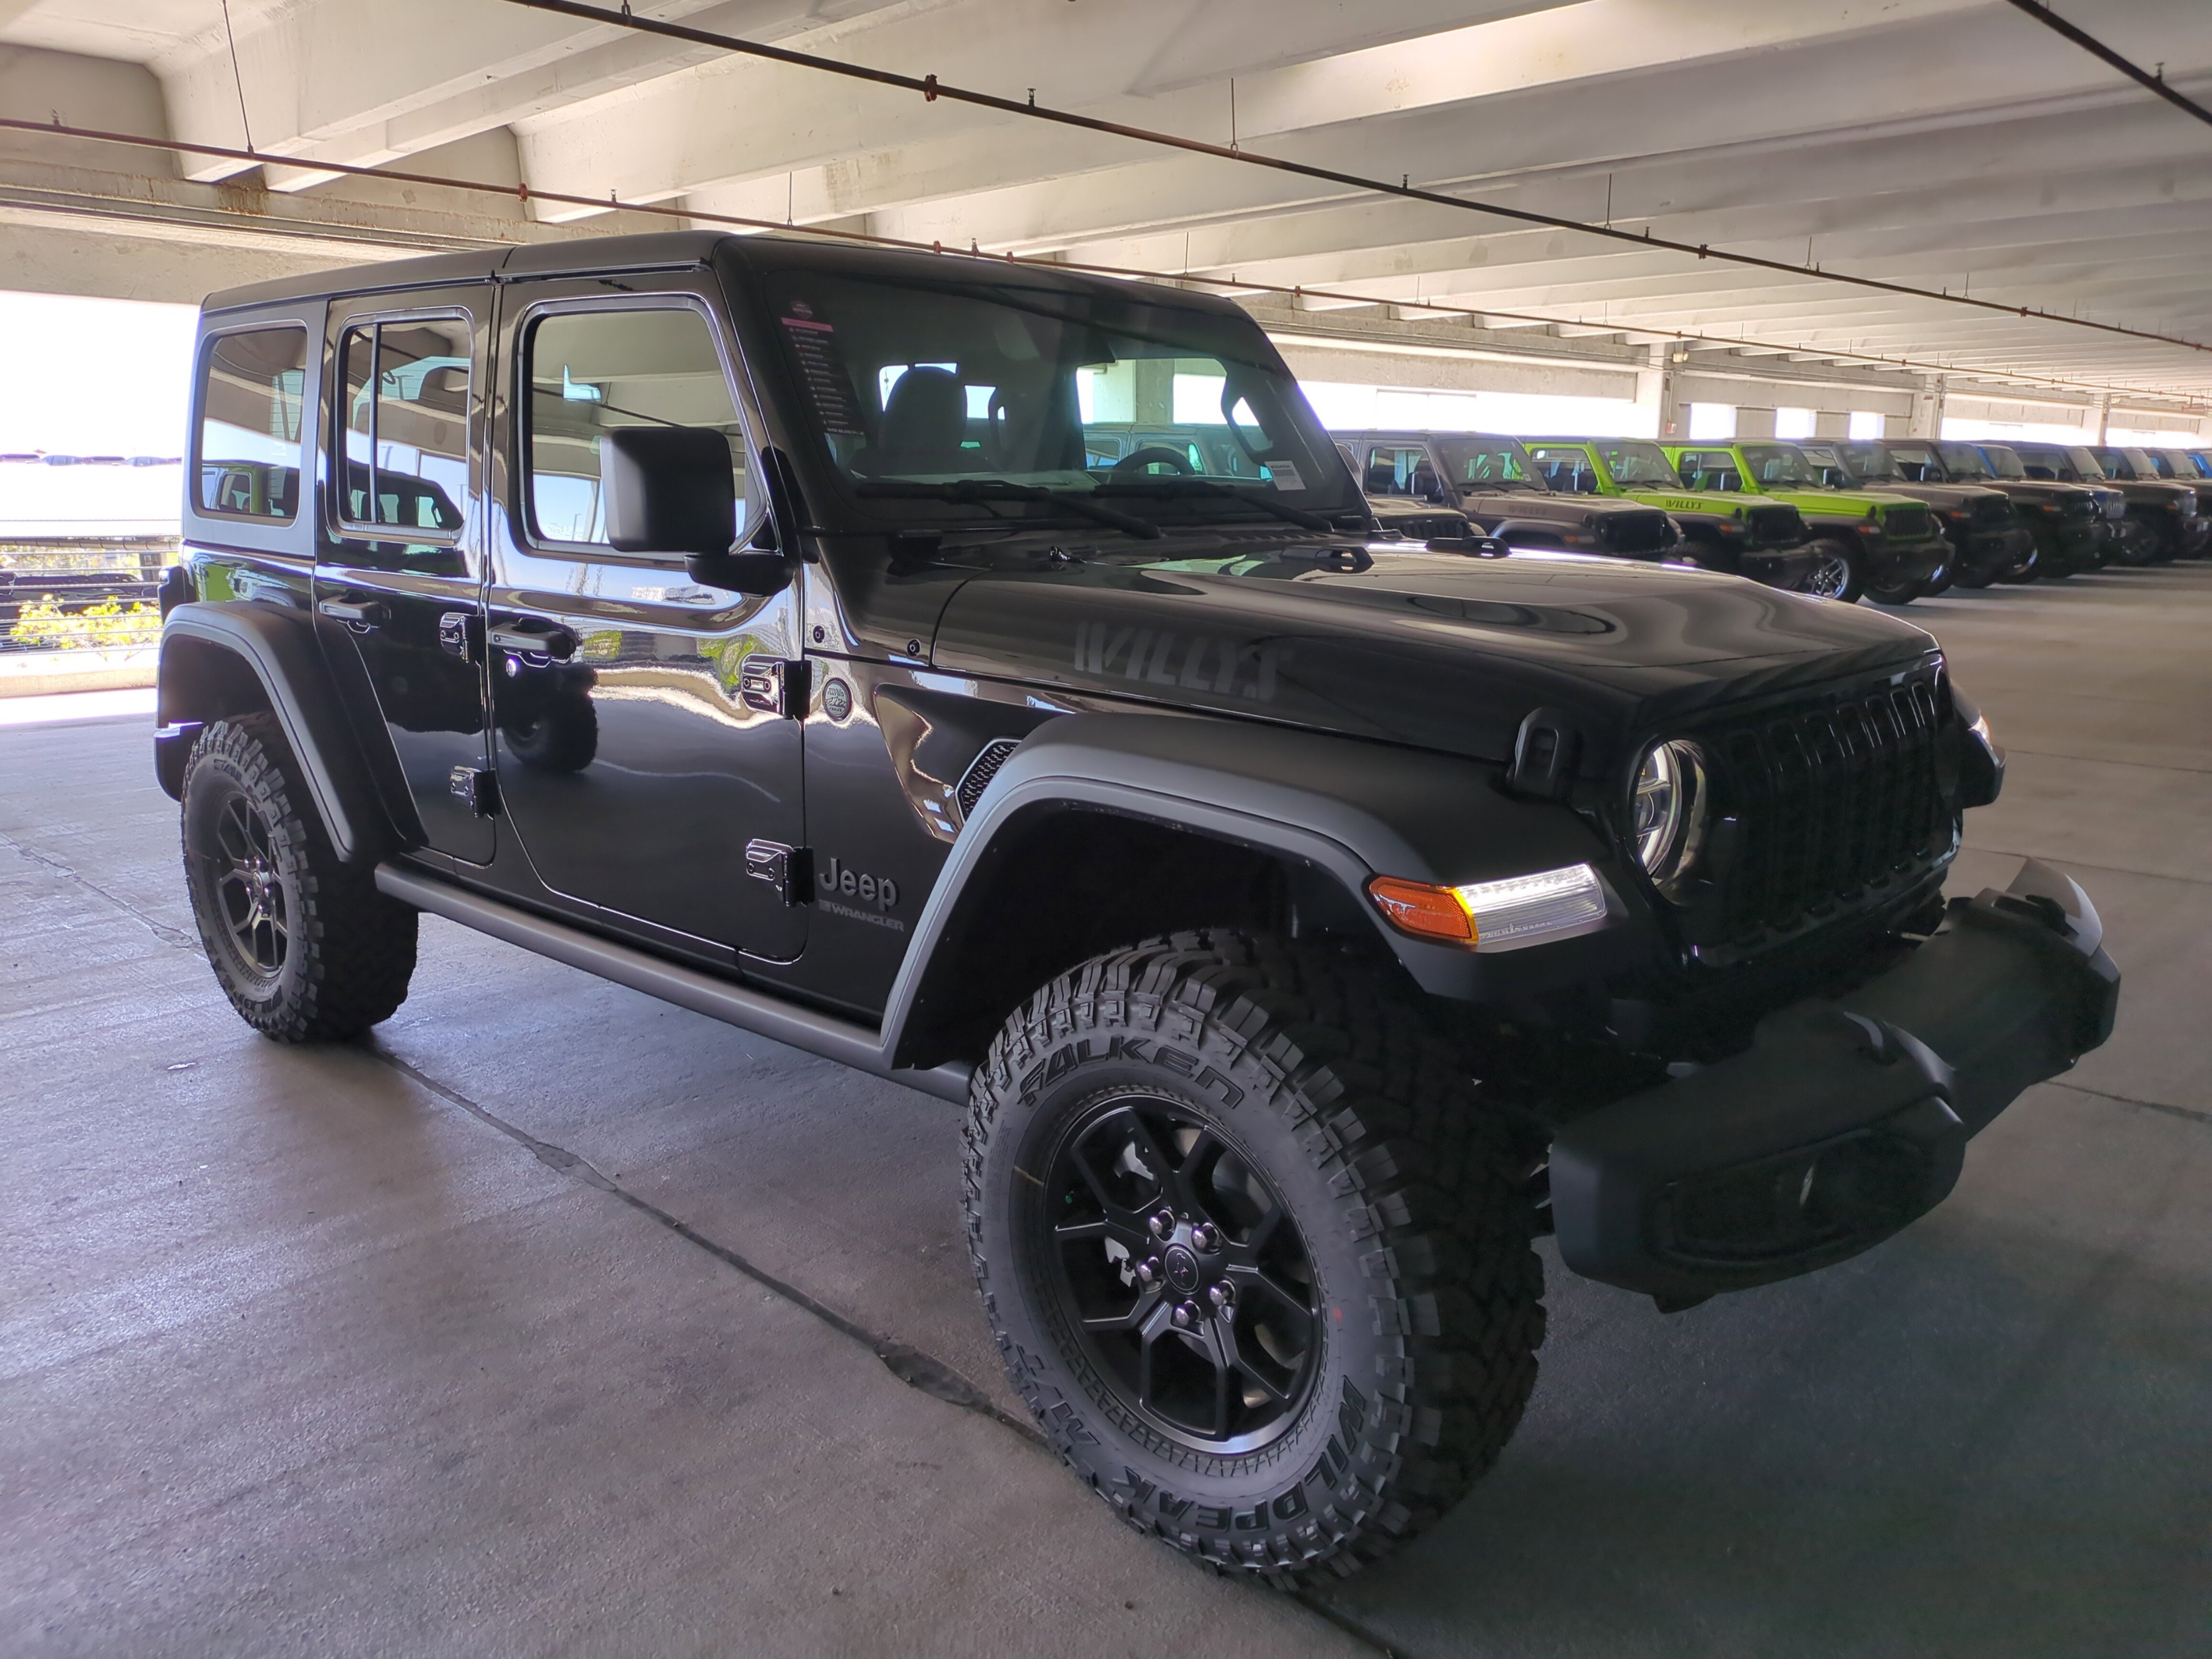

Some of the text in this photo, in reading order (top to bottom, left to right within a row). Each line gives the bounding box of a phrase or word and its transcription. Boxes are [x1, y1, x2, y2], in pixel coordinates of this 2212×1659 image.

[1666, 499, 1704, 510] WILLYS
[1074, 621, 1293, 700] WILLYS
[819, 857, 899, 912] Jeep
[831, 902, 904, 932] WRANGLER
[1017, 1034, 1244, 1109] FALKEN
[1112, 1374, 1366, 1532] WILDPEAK
